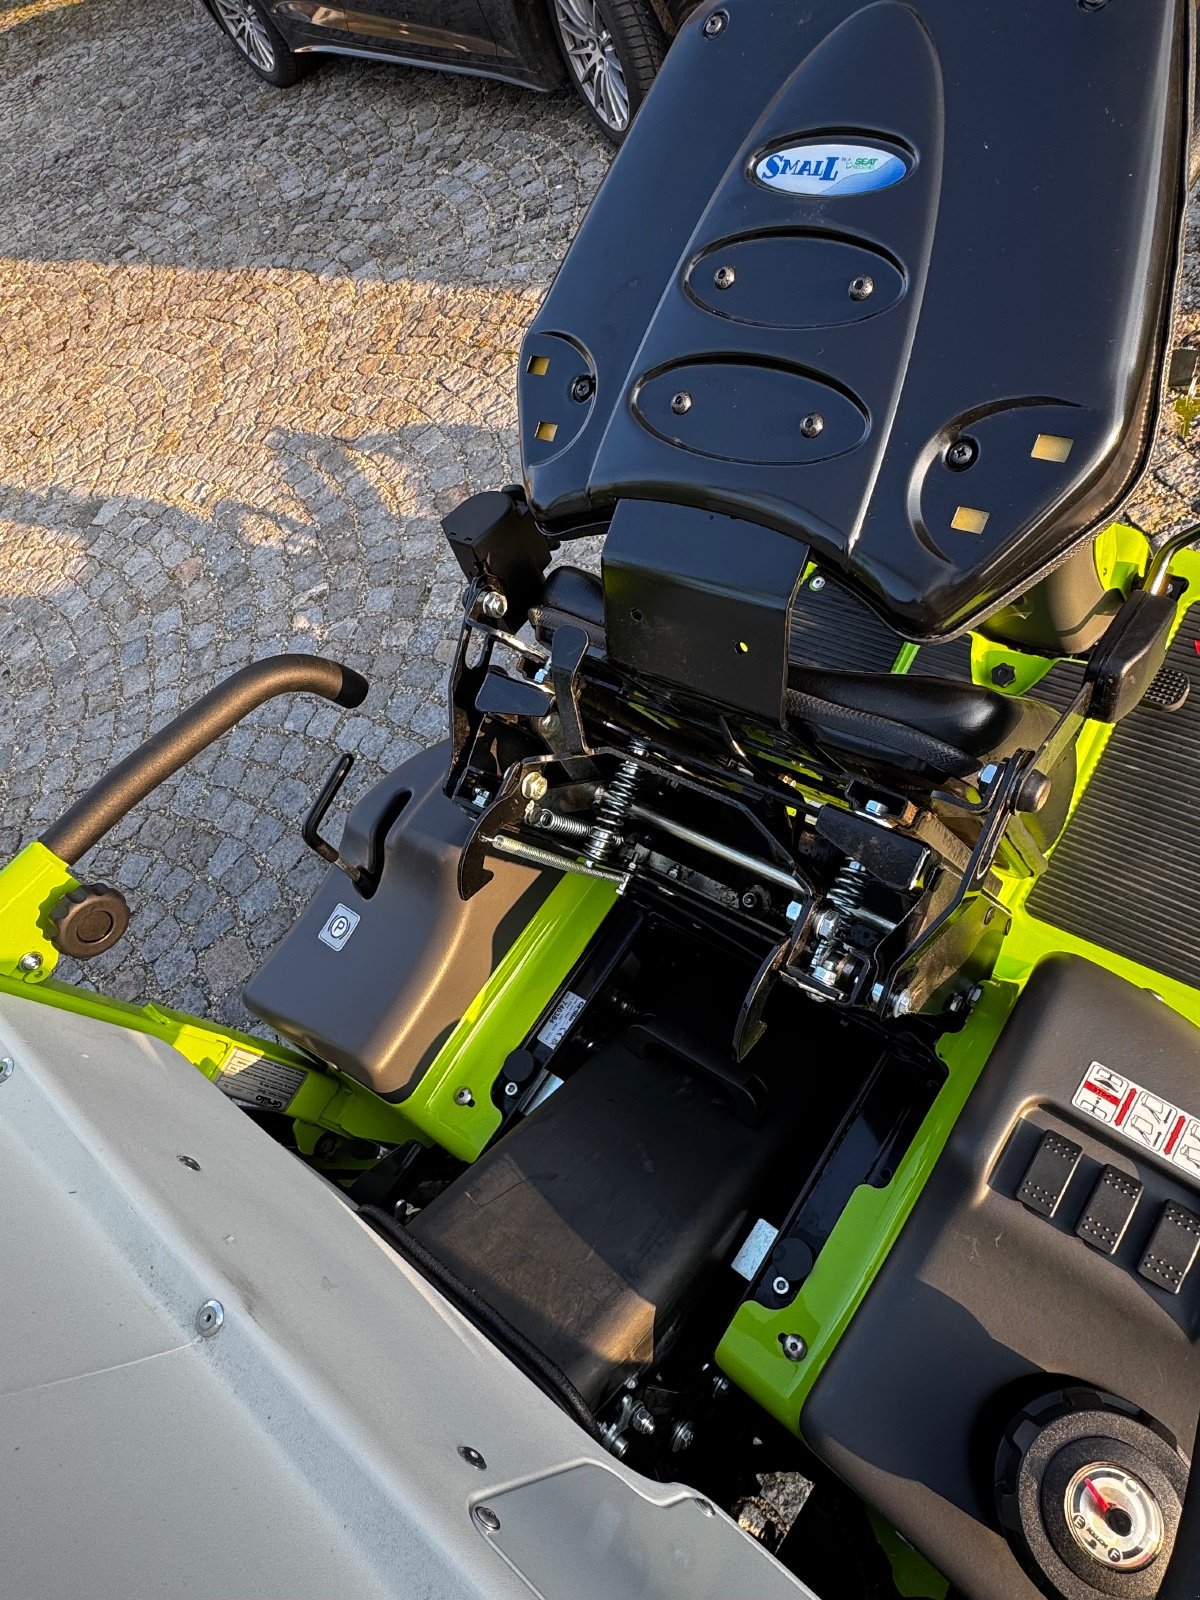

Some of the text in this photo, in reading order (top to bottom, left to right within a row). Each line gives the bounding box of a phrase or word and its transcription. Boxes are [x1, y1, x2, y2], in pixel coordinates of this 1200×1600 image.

[854, 157, 878, 166] SEAT
[333, 920, 346, 932] P
[1092, 1086, 1112, 1100] STOP
[255, 1094, 283, 1109] Grillo
[1073, 1515, 1085, 1529] E
[1109, 1549, 1120, 1560] F
